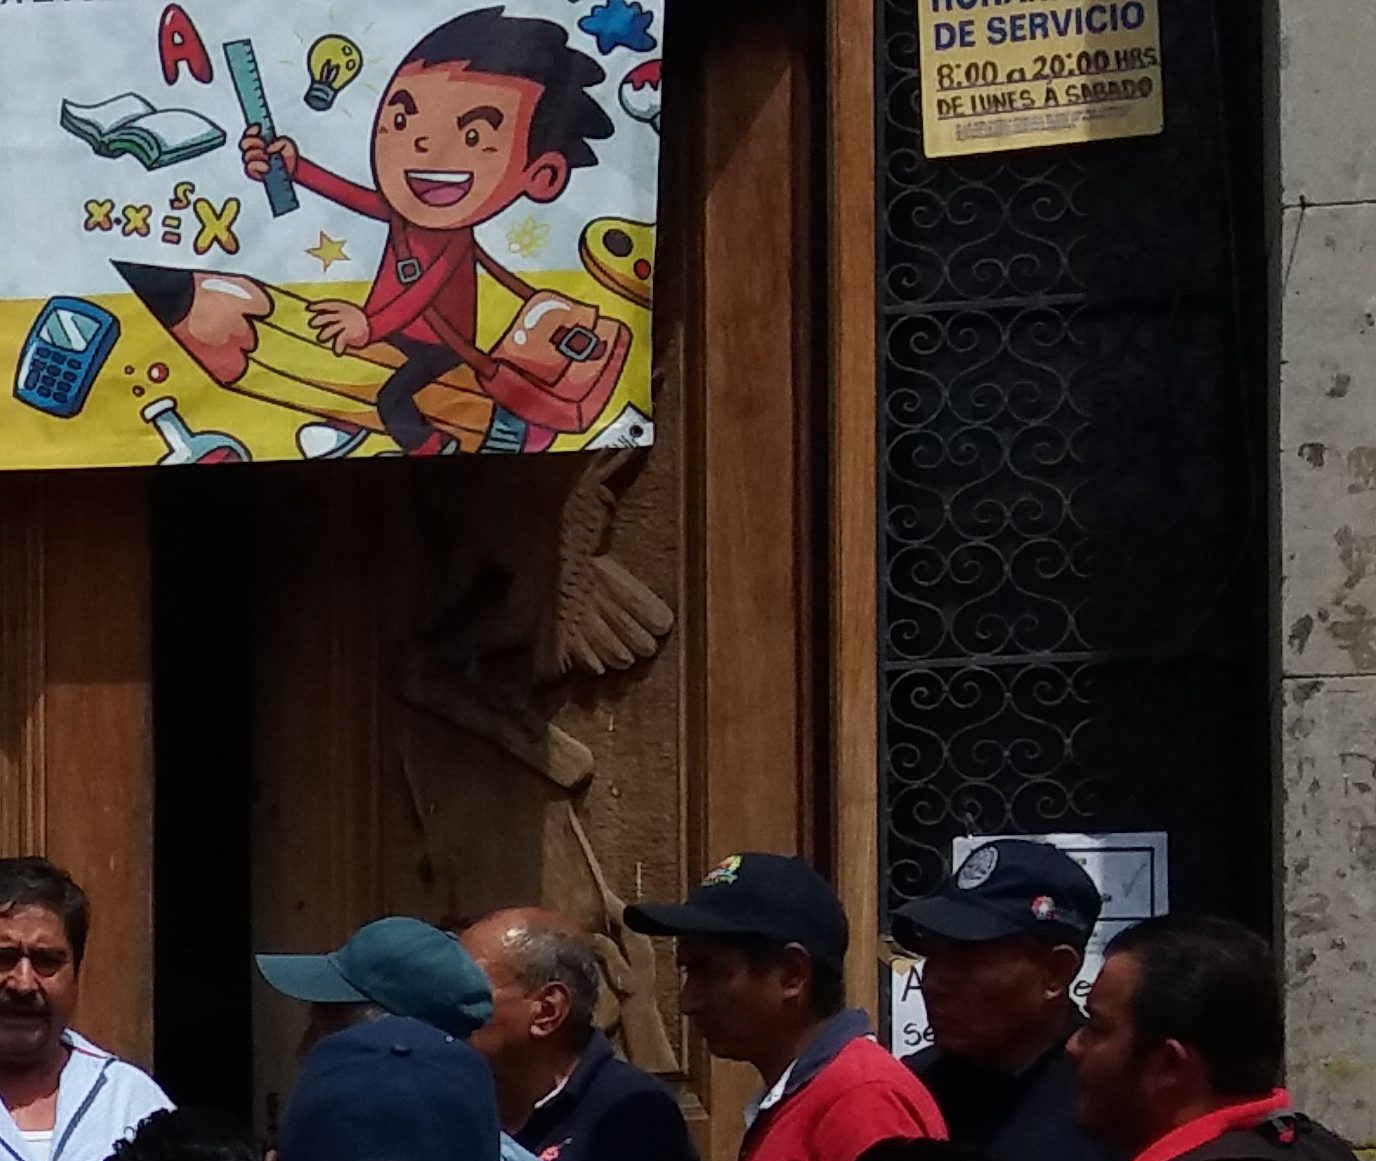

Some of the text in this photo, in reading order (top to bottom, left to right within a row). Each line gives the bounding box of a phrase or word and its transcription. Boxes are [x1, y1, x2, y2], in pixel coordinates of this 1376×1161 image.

[934, 1, 1145, 51] DE SERVICIO
[936, 60, 999, 91] 8:00
[1032, 51, 1111, 81] 20:00
